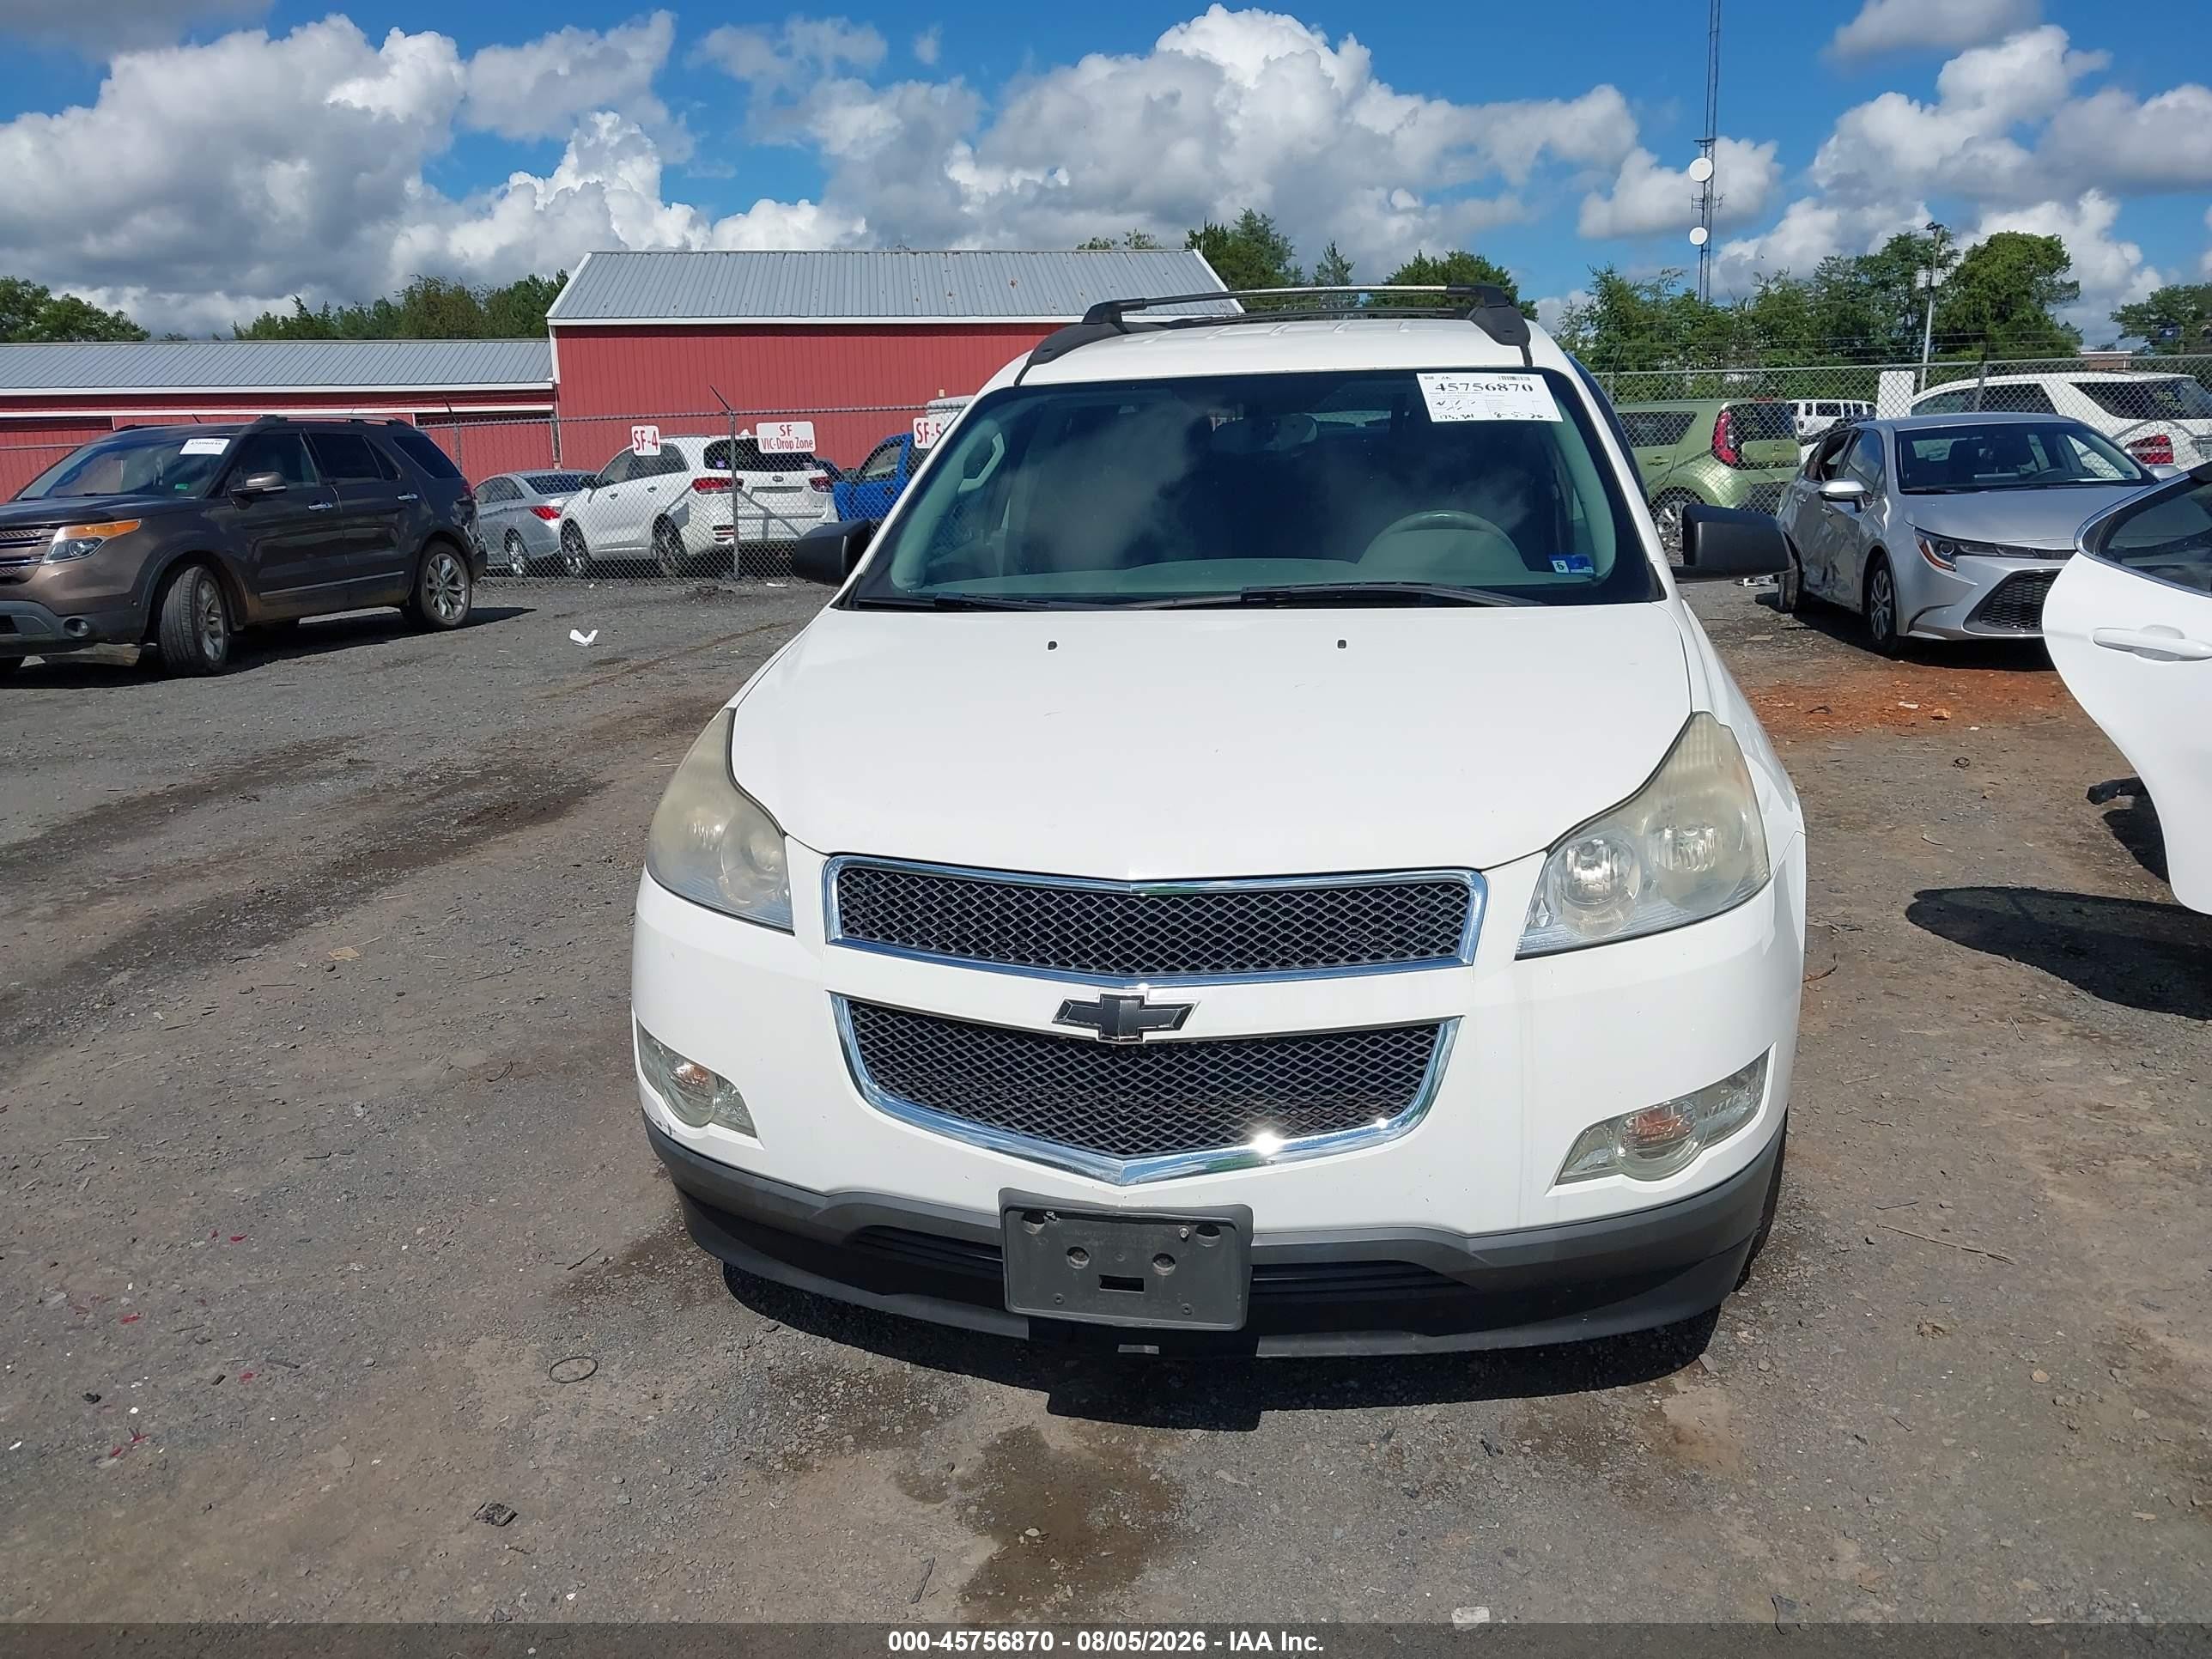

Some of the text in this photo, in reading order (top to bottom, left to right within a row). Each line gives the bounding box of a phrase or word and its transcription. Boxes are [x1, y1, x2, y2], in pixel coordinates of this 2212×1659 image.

[1435, 383, 1534, 392] 45756870
[780, 424, 793, 436] SF
[916, 422, 941, 444] SF-5
[634, 430, 658, 451] SF-4
[761, 437, 813, 451] VIC-Drop Zone
